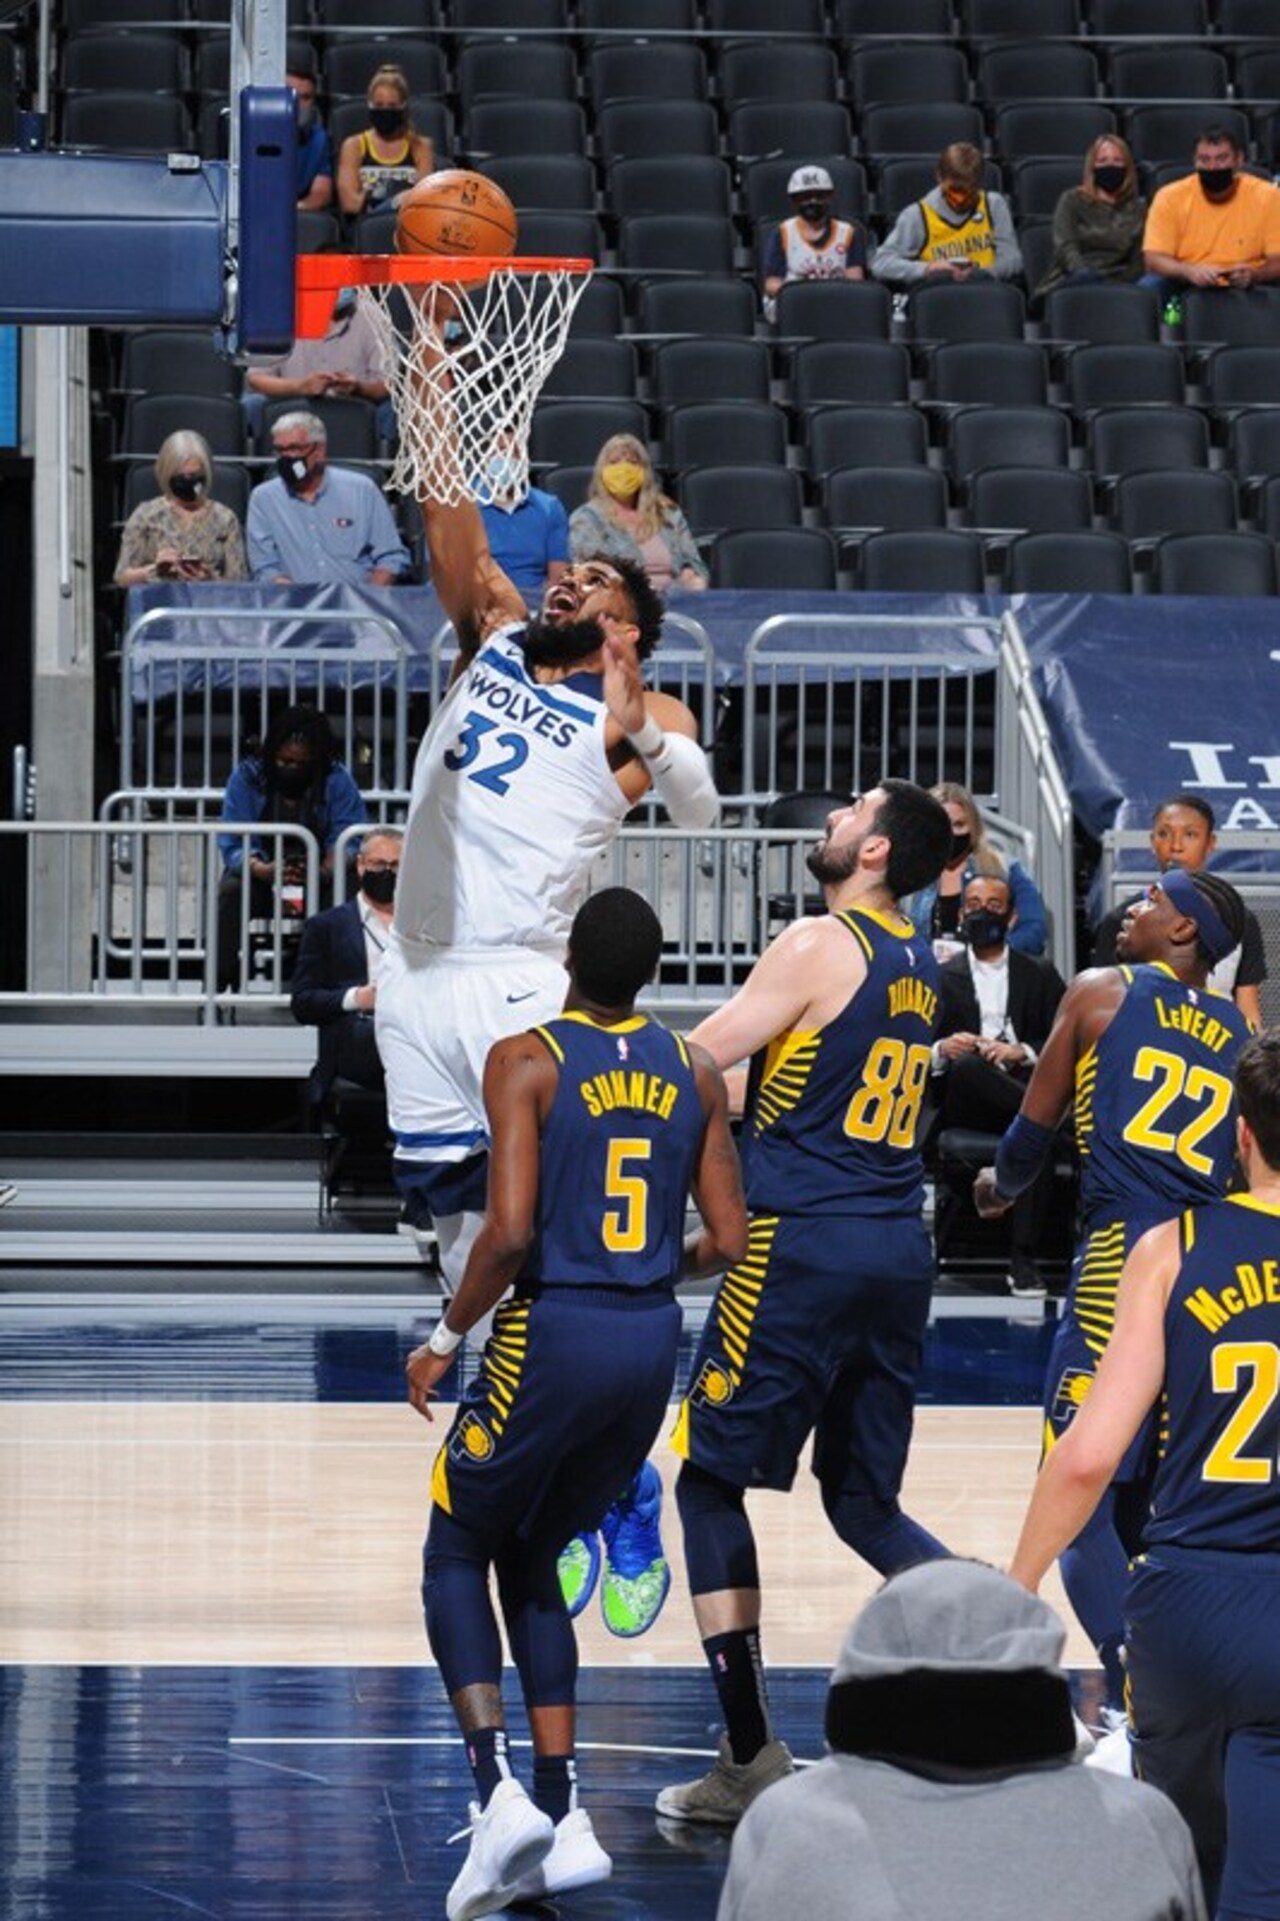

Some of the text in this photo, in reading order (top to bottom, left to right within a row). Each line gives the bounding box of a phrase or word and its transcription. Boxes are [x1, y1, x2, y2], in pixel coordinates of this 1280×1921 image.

[931, 233, 995, 261] INDIANA
[443, 710, 529, 797] 32
[468, 672, 578, 748] WOLVES
[580, 1070, 678, 1120] SUMNER
[843, 1037, 932, 1149] 88
[1123, 1046, 1234, 1175] 22
[602, 1137, 651, 1252] 5
[1202, 1341, 1280, 1483] 2
